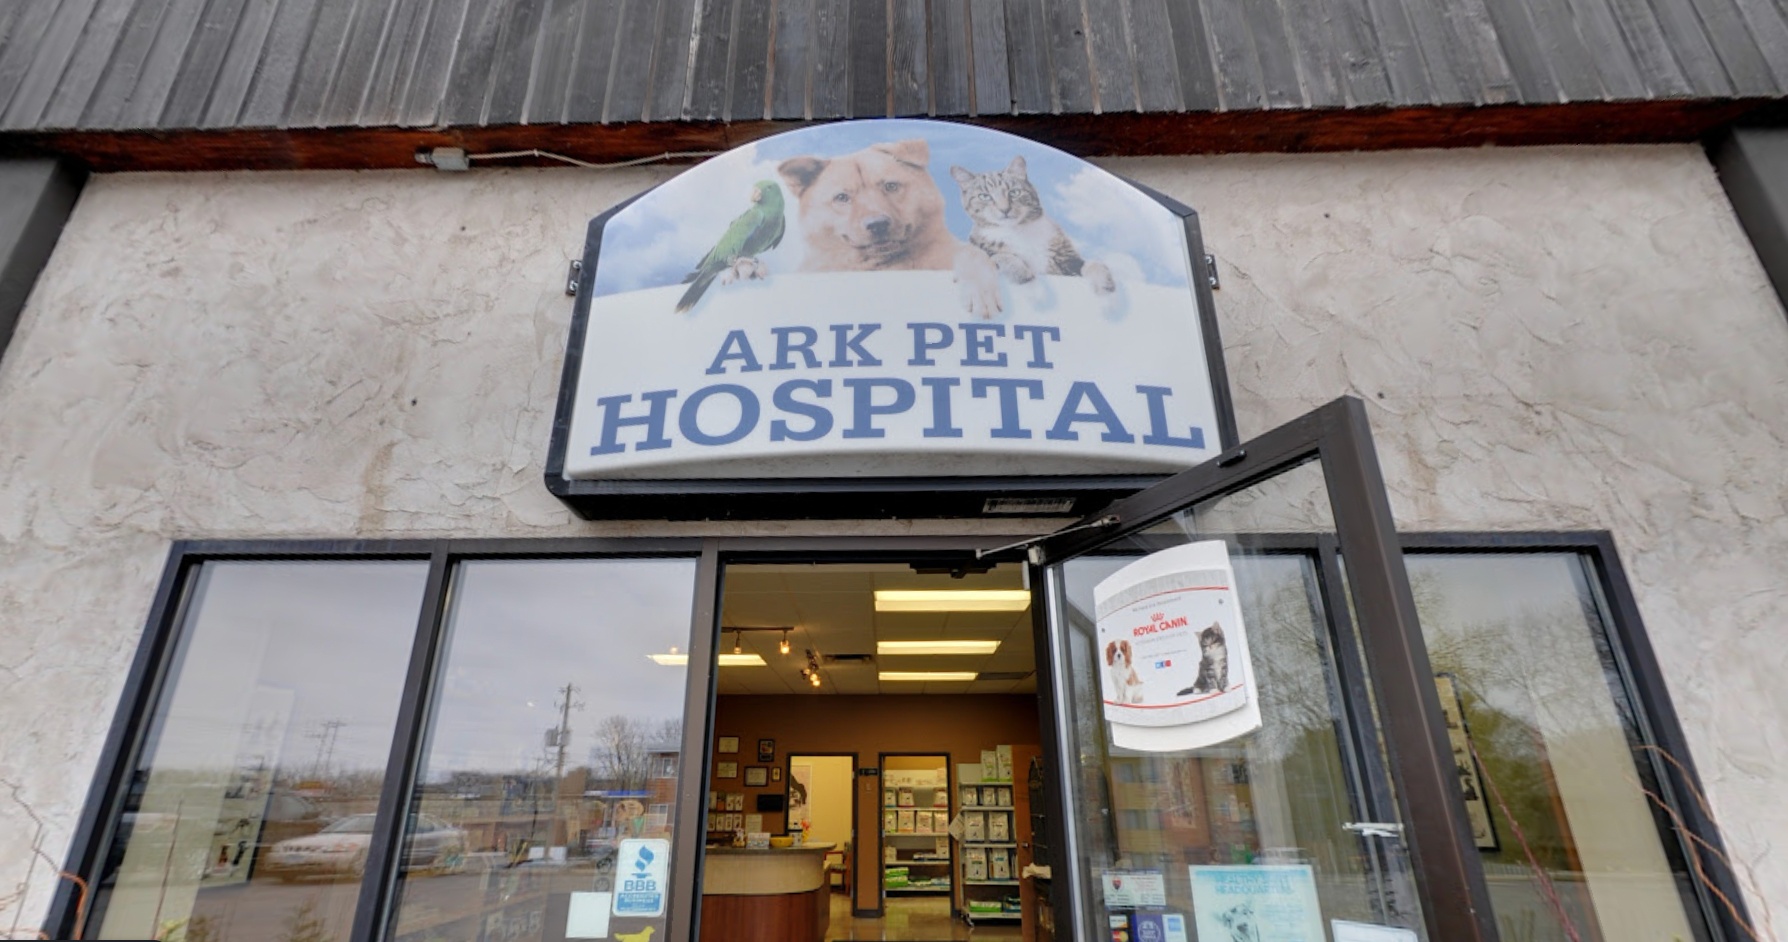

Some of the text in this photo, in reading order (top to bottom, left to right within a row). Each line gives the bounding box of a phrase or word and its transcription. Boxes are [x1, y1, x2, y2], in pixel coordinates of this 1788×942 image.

[705, 322, 1061, 375] ARK PET
[590, 376, 1206, 456] HOSPITAL
[1133, 617, 1187, 637] ROYAL CANIN
[624, 880, 657, 891] BBB
